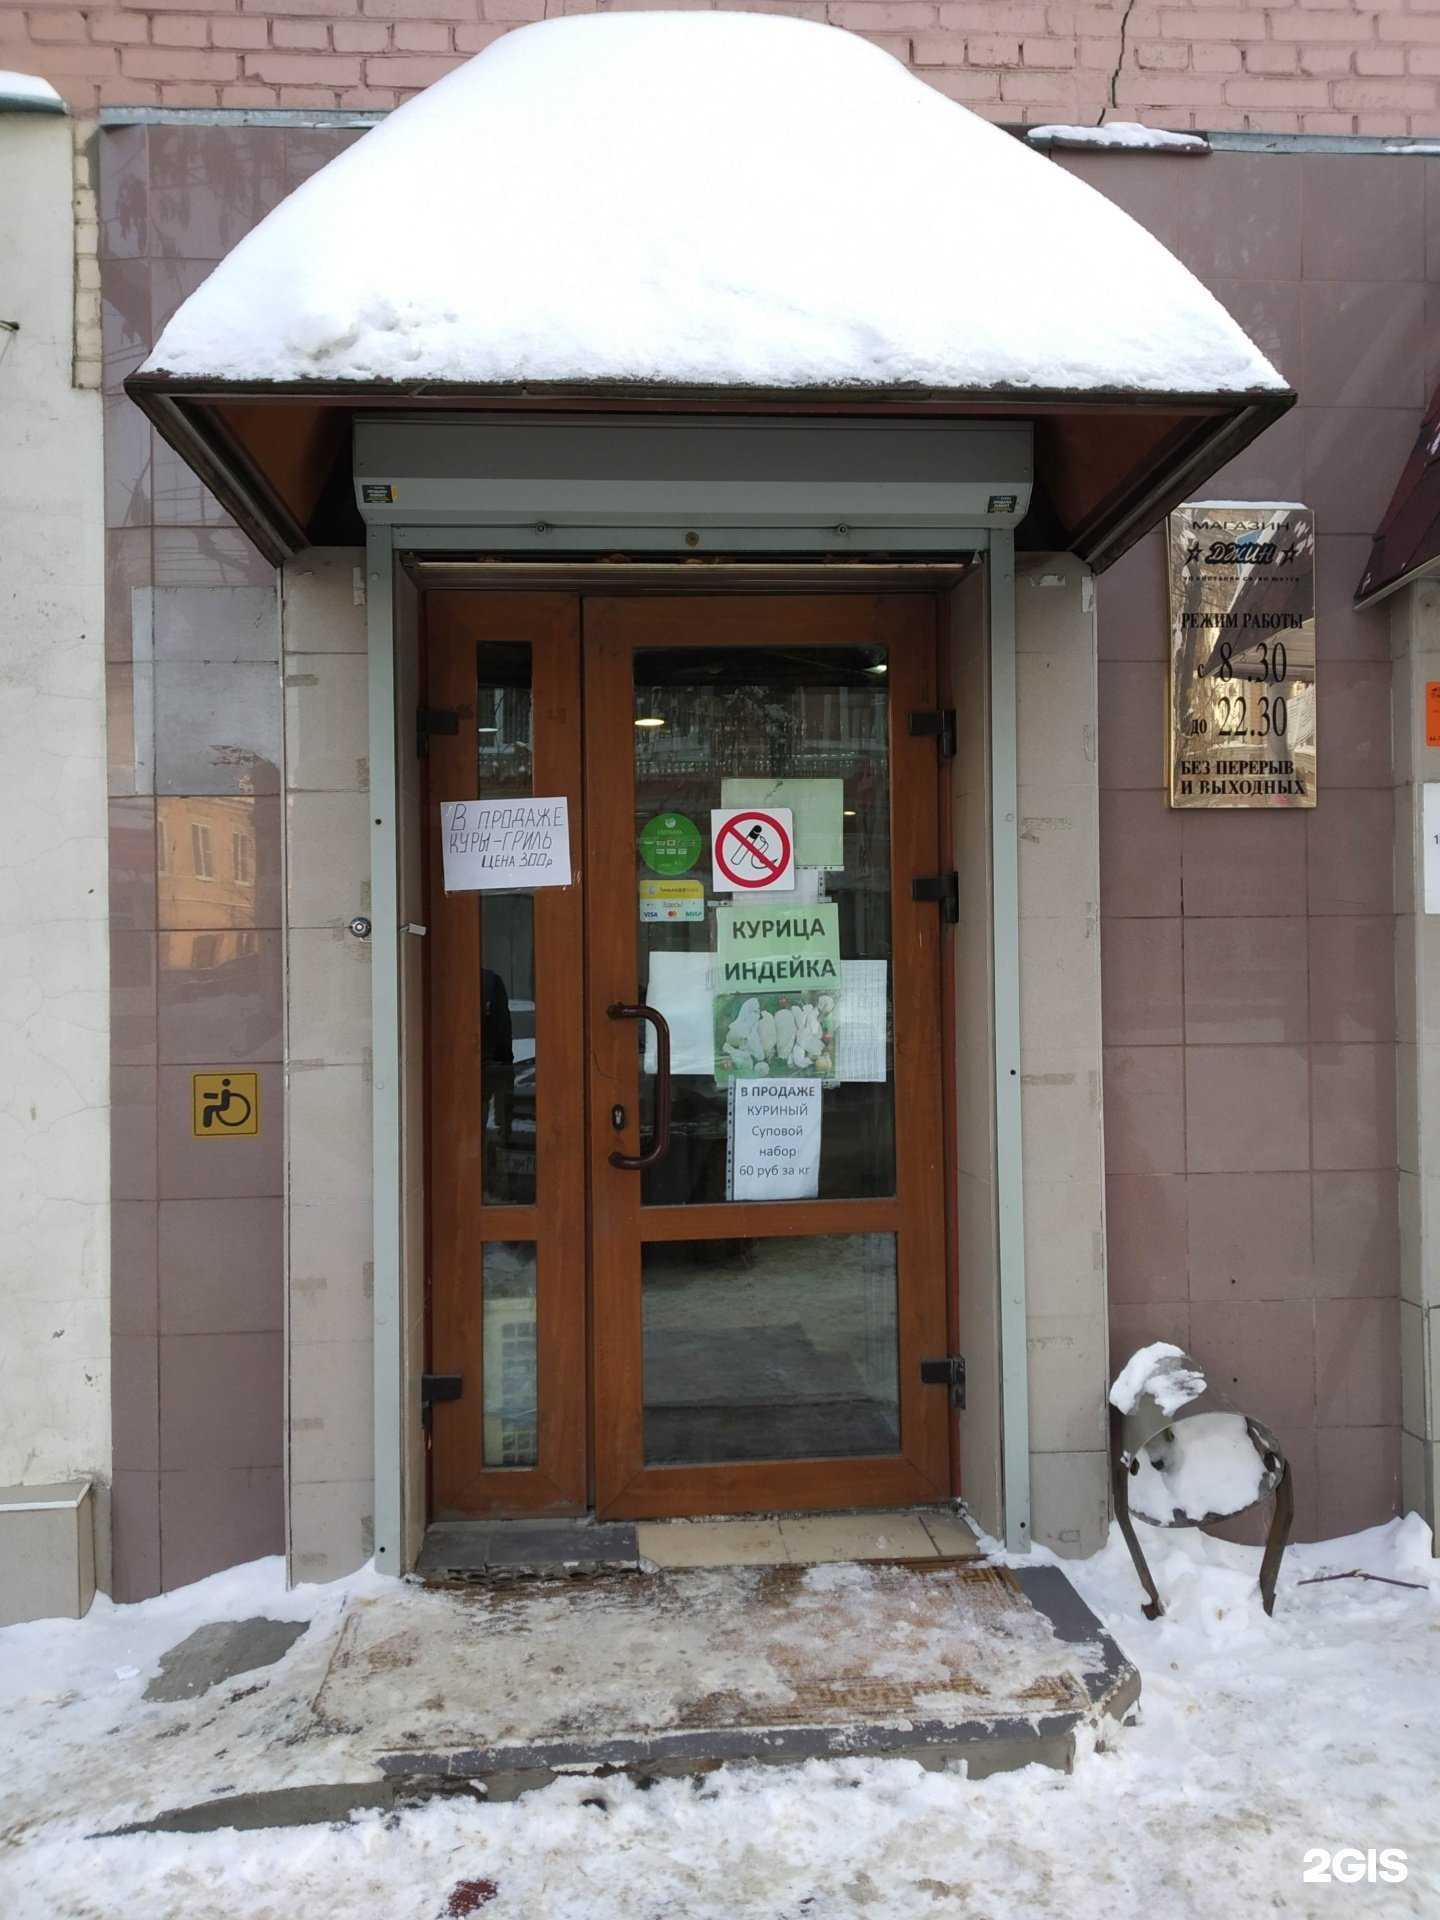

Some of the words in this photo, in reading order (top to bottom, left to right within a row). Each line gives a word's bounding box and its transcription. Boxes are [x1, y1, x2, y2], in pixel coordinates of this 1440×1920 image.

[1192, 521, 1290, 531] МАГАЗИН
[1205, 541, 1278, 565] ДЖИН
[1182, 612, 1238, 629] РЕЖИМ
[1243, 612, 1303, 629] РАБОТЫ
[1217, 696, 1288, 737] 22.30
[1181, 760, 1211, 775] БЕЗ
[1216, 760, 1294, 775] ПЕРЕРЫВ
[1181, 780, 1193, 795] И
[1200, 780, 1305, 796] ВЫХОДНЫХ
[451, 803, 467, 831] В
[477, 806, 565, 829] ПРОДАЖЕ
[481, 854, 515, 869] ЦЕНА
[732, 918, 826, 940] КУРИЦА
[725, 955, 836, 983] ИНДЕЙКА
[741, 1086, 748, 1097] В
[752, 1086, 815, 1099] ПРОДАЖЕ
[747, 1103, 808, 1116] КУРИНЫЙ
[752, 1125, 803, 1138] Суповой
[759, 1145, 797, 1158] набор
[739, 1165, 754, 1176] 60
[757, 1165, 779, 1178] руб
[782, 1168, 795, 1176] за
